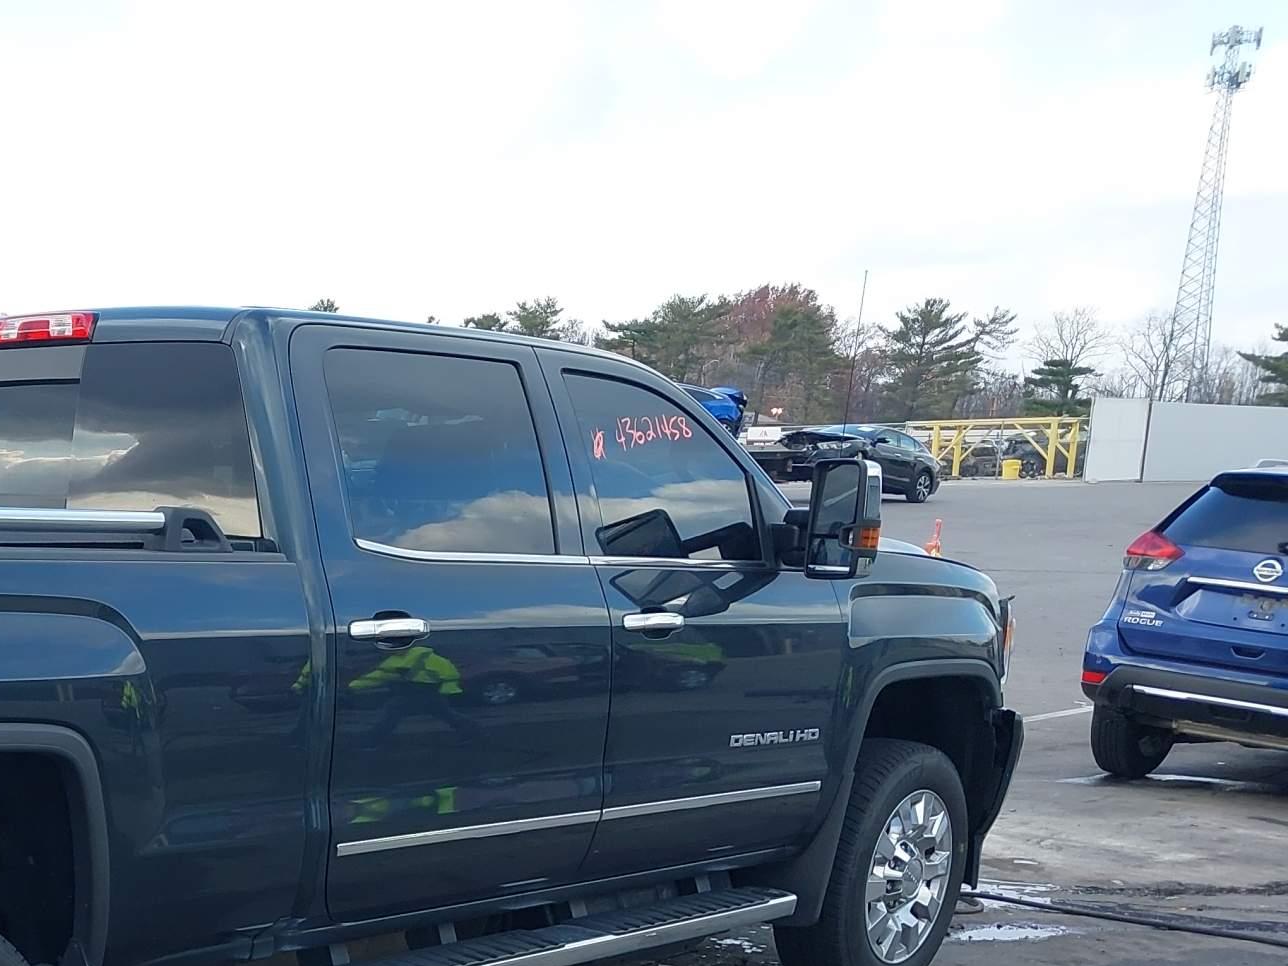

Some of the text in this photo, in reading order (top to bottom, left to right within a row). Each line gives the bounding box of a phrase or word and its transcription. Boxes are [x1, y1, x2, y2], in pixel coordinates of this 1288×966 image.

[615, 414, 693, 451] 43621458
[1123, 616, 1164, 627] ROGUE
[730, 728, 820, 748] DENALI HD
